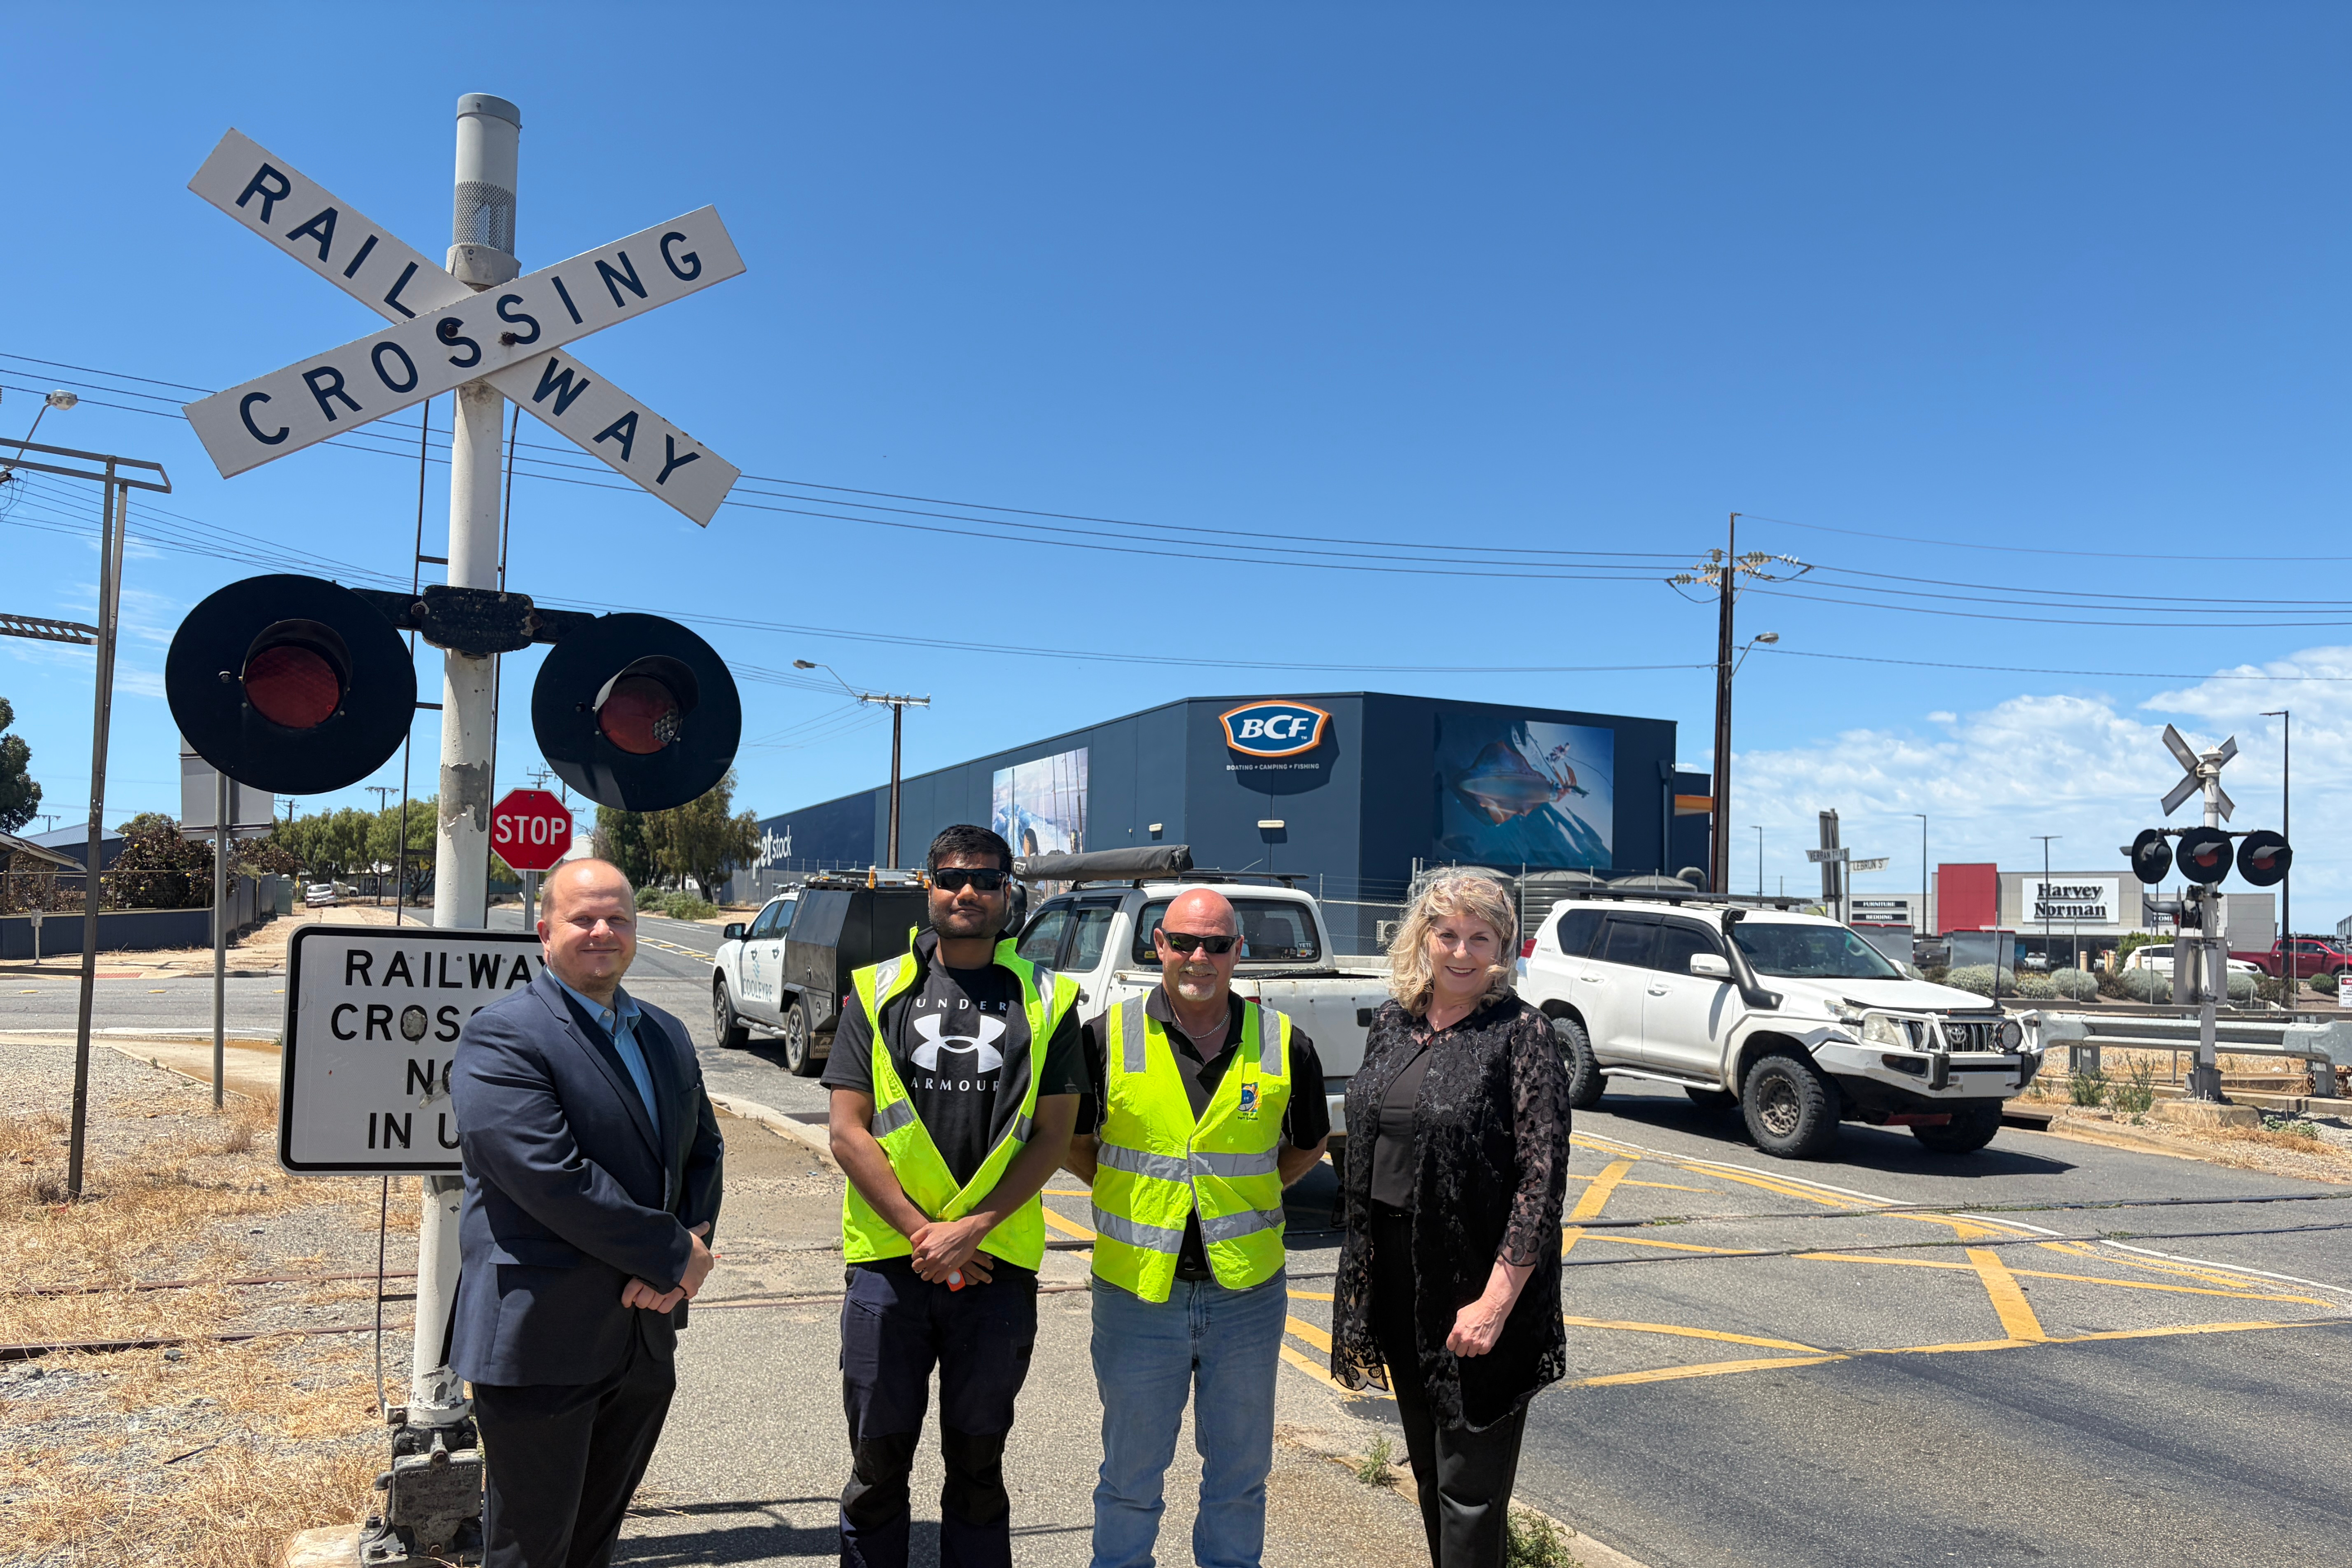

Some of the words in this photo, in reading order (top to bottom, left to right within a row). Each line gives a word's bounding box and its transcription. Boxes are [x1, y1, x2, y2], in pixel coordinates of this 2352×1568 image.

[235, 162, 418, 319] RAIL
[532, 356, 701, 486] WAY
[238, 230, 703, 446] CROSSING
[1239, 715, 1309, 739] BCF
[495, 815, 567, 845] STOP
[1810, 850, 1830, 861] VERRAN
[1853, 860, 1876, 871] LEBRUN
[2037, 883, 2103, 899] Harvey
[2034, 902, 2106, 916] Norman
[345, 950, 546, 990] RAILWA
[743, 978, 772, 1002] COOLEYRE
[916, 998, 1007, 1011] UNDER
[331, 1003, 485, 1042] CROS
[368, 1113, 411, 1149] IN
